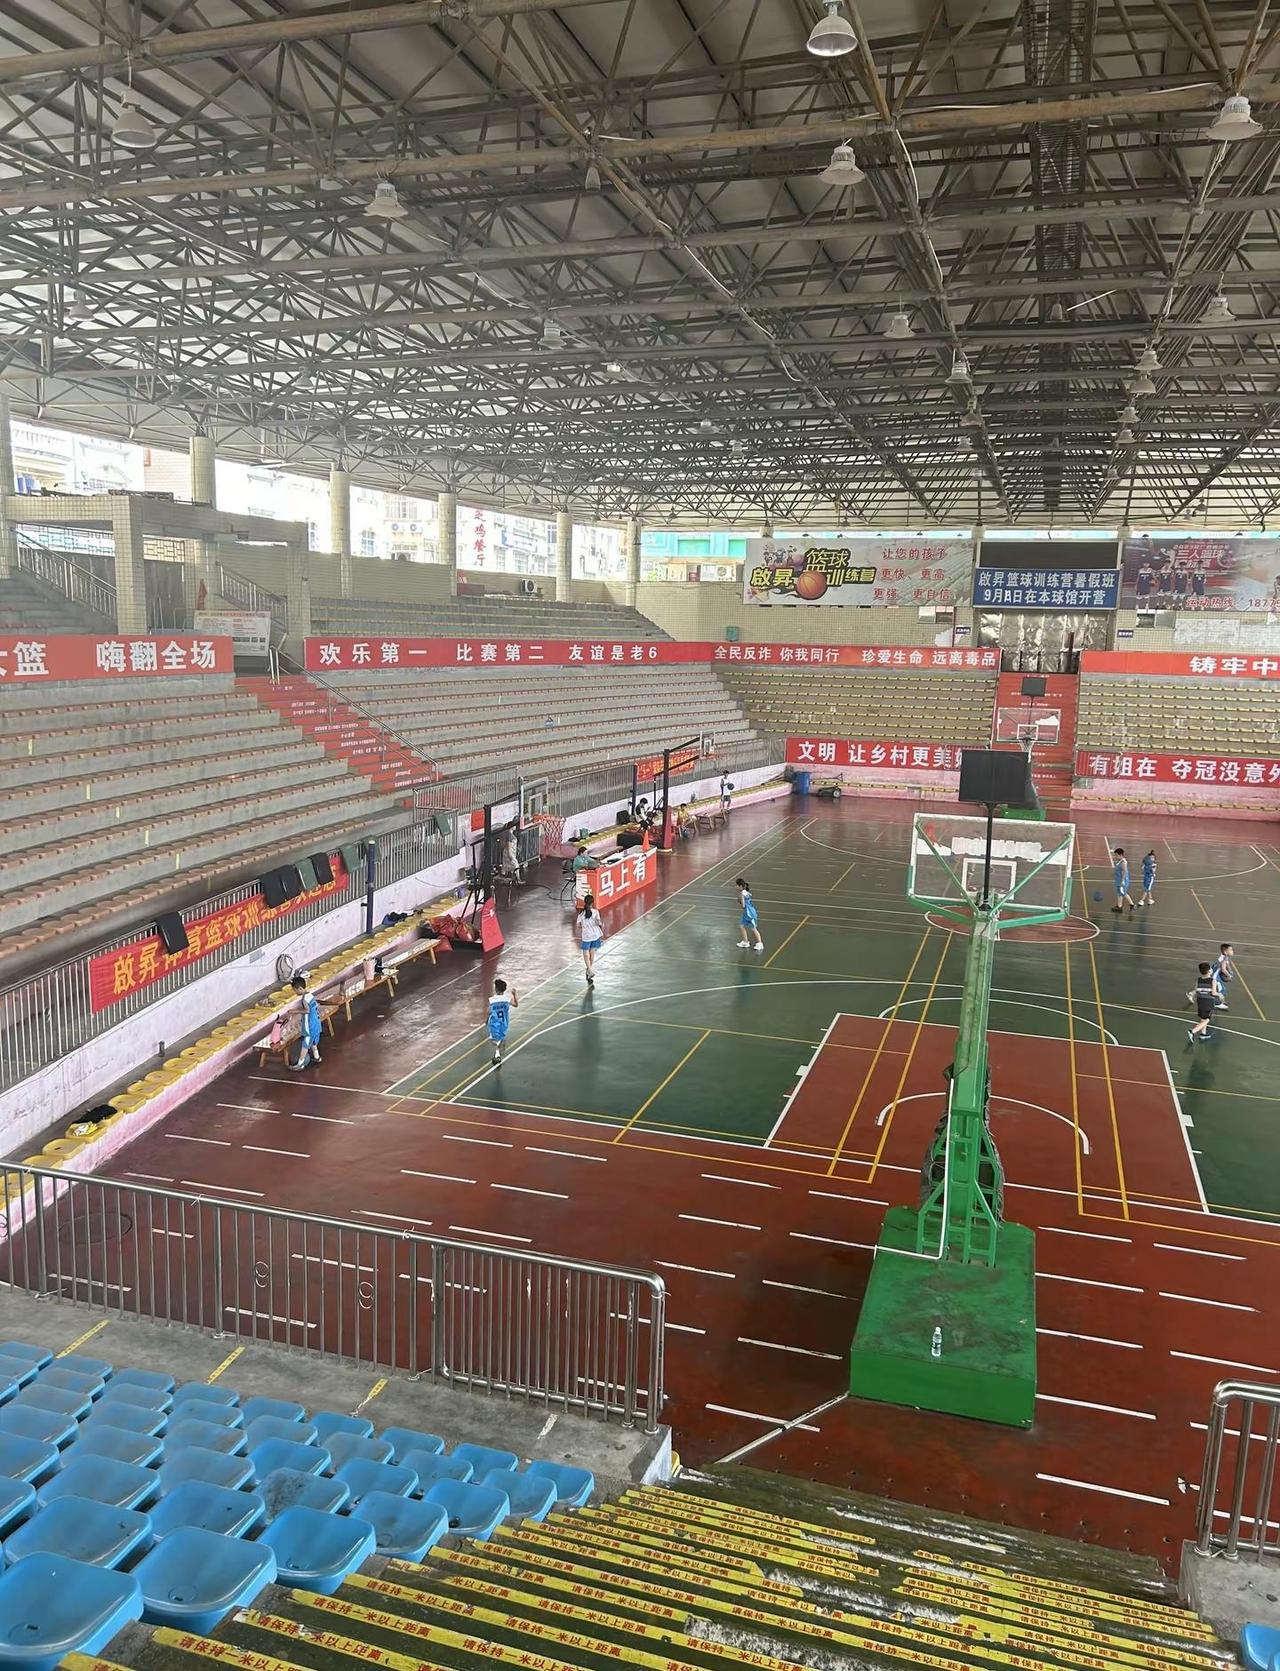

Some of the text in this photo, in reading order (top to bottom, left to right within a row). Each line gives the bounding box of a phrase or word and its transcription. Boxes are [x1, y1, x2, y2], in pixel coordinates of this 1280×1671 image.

[806, 549, 849, 573] 篮球
[882, 547, 946, 560] 让您的孩子
[827, 568, 876, 586] 训练营
[96, 640, 216, 673] 嗨翻全场
[319, 642, 658, 665] 欢乐第一 比赛第二 友谊是老6
[714, 645, 996, 667] 全民反诈 你我同行 珍爱生命 远离毒品
[1189, 656, 1278, 676] 铸牢中
[798, 740, 836, 762] 文明
[1089, 754, 1158, 778] 有姐在
[599, 853, 647, 897] 马上有
[484, 1543, 574, 1571] 请保持一米以上距离
[621, 1556, 712, 1586] 请保持一米以上距离
[366, 1579, 476, 1617] 请保持一米以上距离
[572, 1583, 673, 1618] 请保持一米以上距离
[600, 1571, 695, 1603] 请保持一米以上距离
[313, 1597, 432, 1638] 请保持一米以上距离
[537, 1598, 647, 1634] 请保持一米以上距离
[732, 1606, 833, 1639] 请保持一米以上距离
[1020, 1614, 1110, 1643] 请保持一米以上距离
[257, 1616, 384, 1662] 请保持米以上距离
[505, 1615, 622, 1657] 请保持一米以上距离
[1024, 1630, 1119, 1659] 请保持一米以上距离
